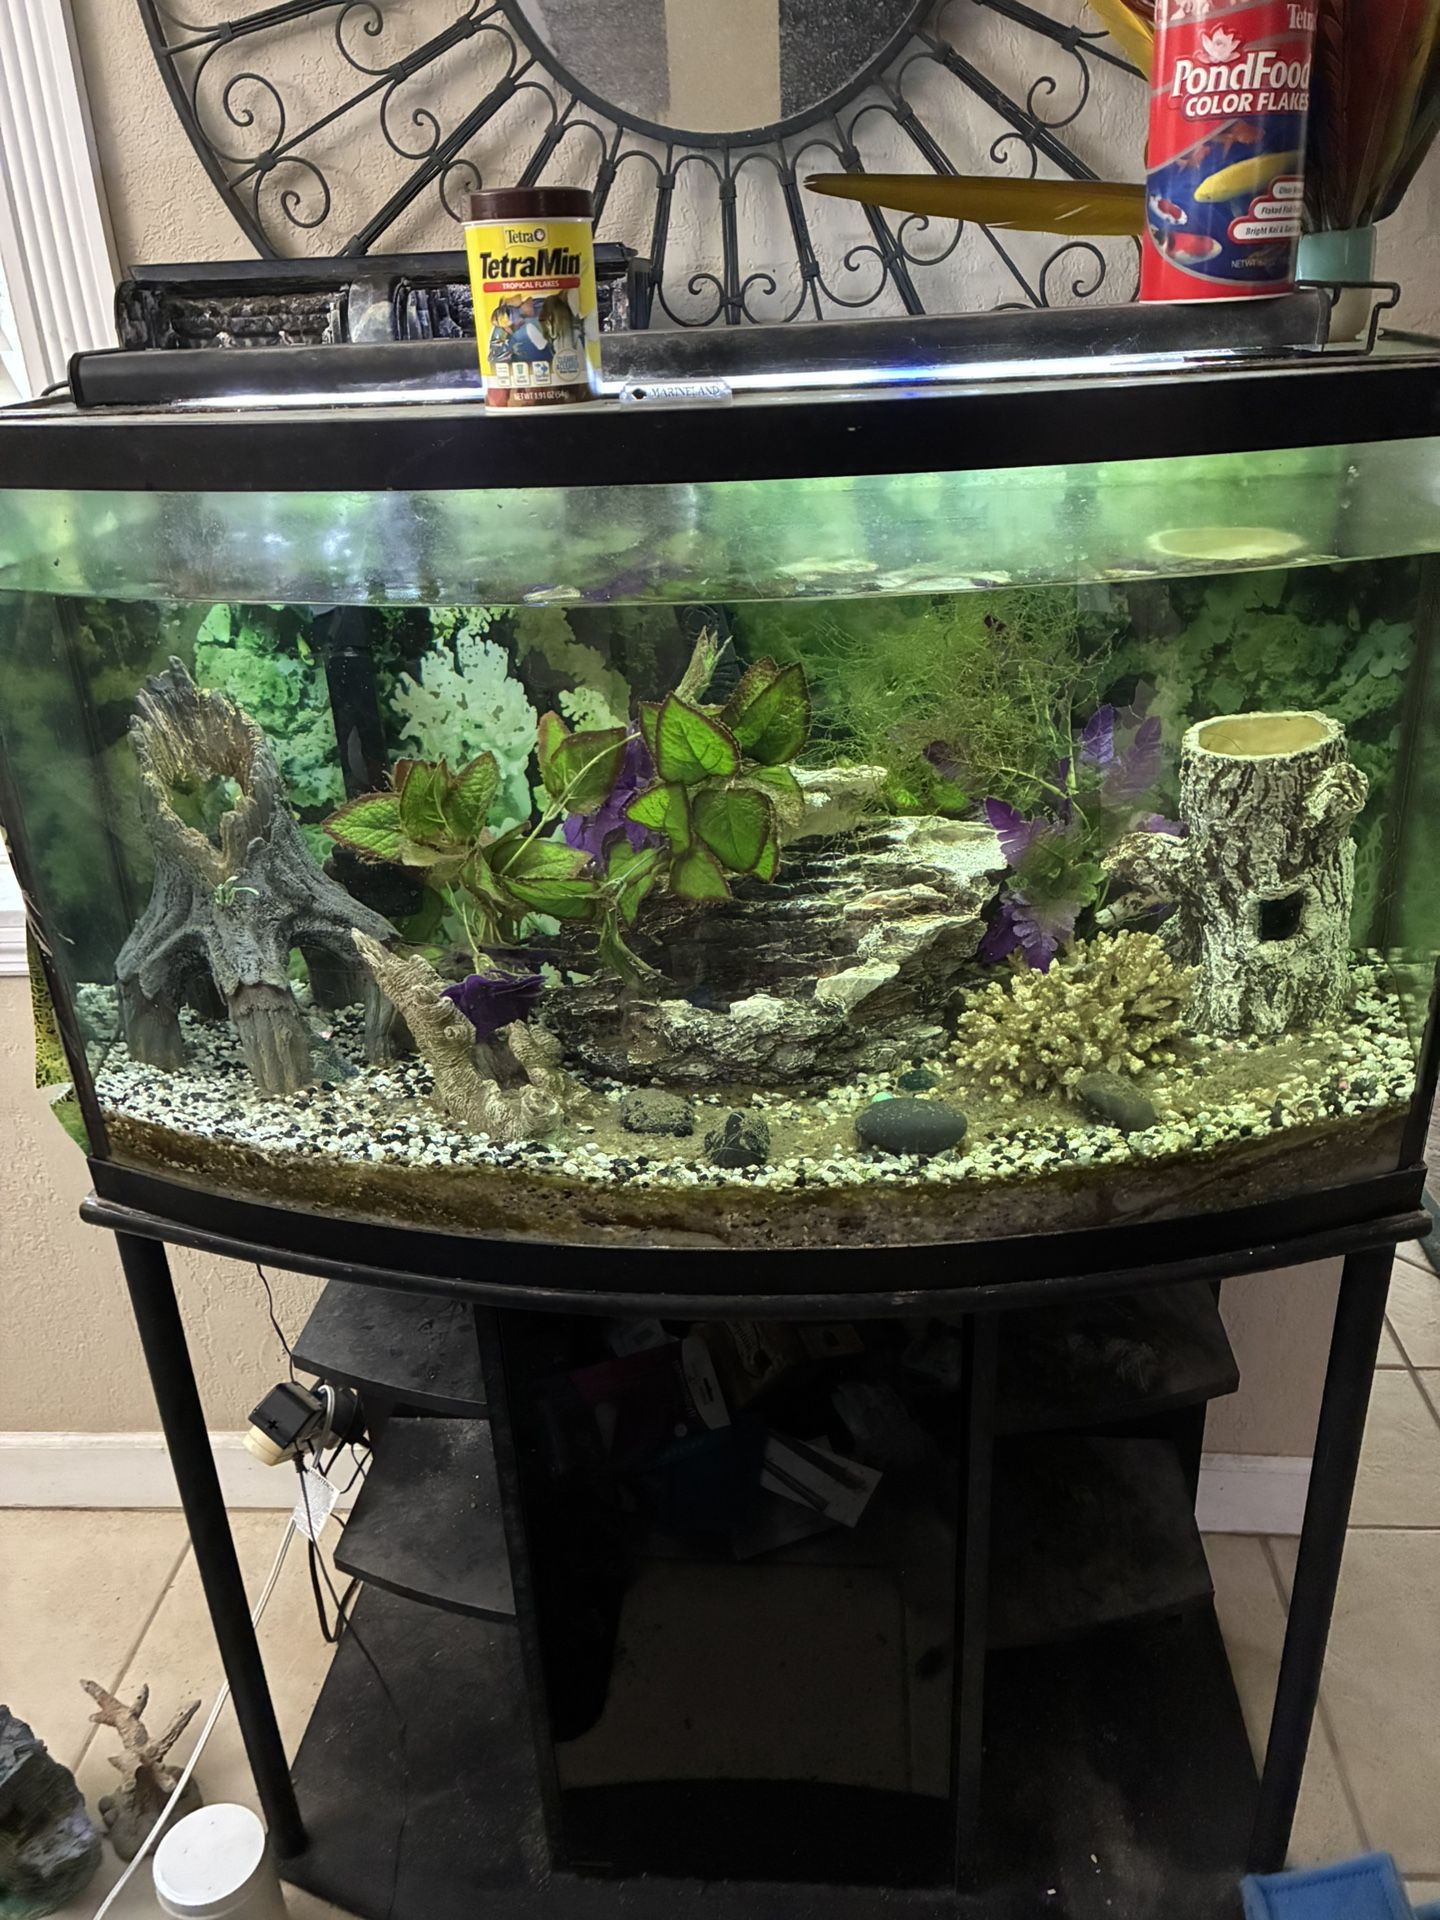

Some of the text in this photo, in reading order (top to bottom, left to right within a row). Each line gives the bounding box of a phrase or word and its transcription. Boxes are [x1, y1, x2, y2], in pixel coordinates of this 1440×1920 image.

[1185, 92, 1309, 117] COLOR FLAKES
[505, 229, 535, 244] Tetra
[1245, 226, 1268, 236] Bright
[480, 247, 580, 279] TetraMin
[502, 280, 559, 290] TROPICAL FLAKES
[650, 385, 720, 398] MARINELAND
